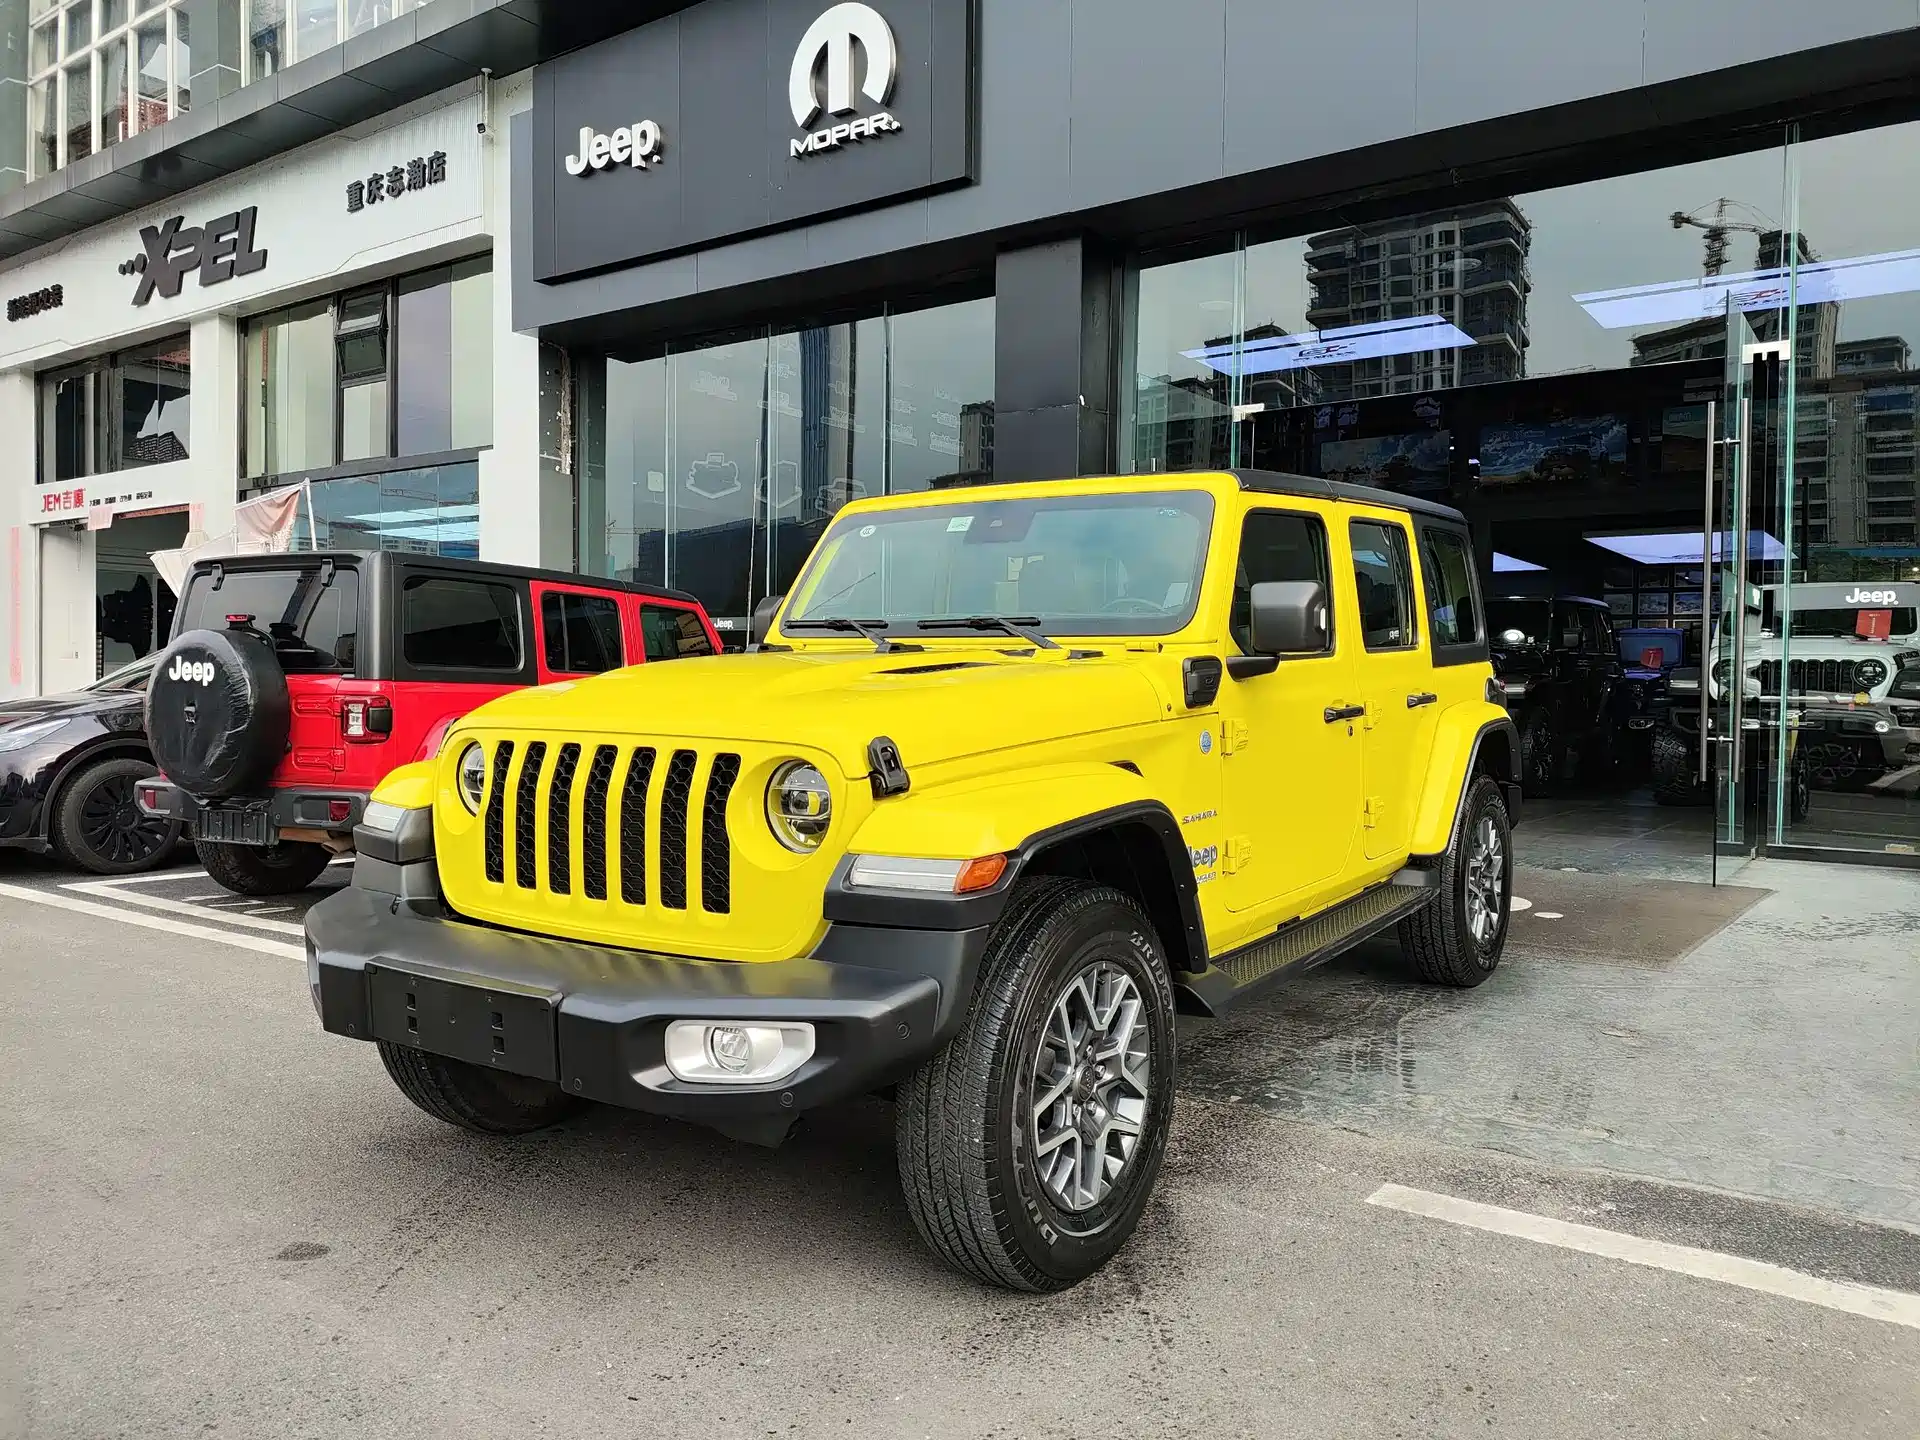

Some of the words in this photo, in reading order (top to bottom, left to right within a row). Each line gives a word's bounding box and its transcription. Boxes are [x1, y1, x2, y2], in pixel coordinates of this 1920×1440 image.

[565, 119, 662, 176] Jeep
[790, 112, 899, 158] MOPAR
[131, 206, 268, 308] XPEL
[1846, 588, 1899, 605] Jeep
[713, 618, 734, 629] Jeep
[169, 655, 215, 686] Jeep
[1182, 810, 1217, 824] SAHARA
